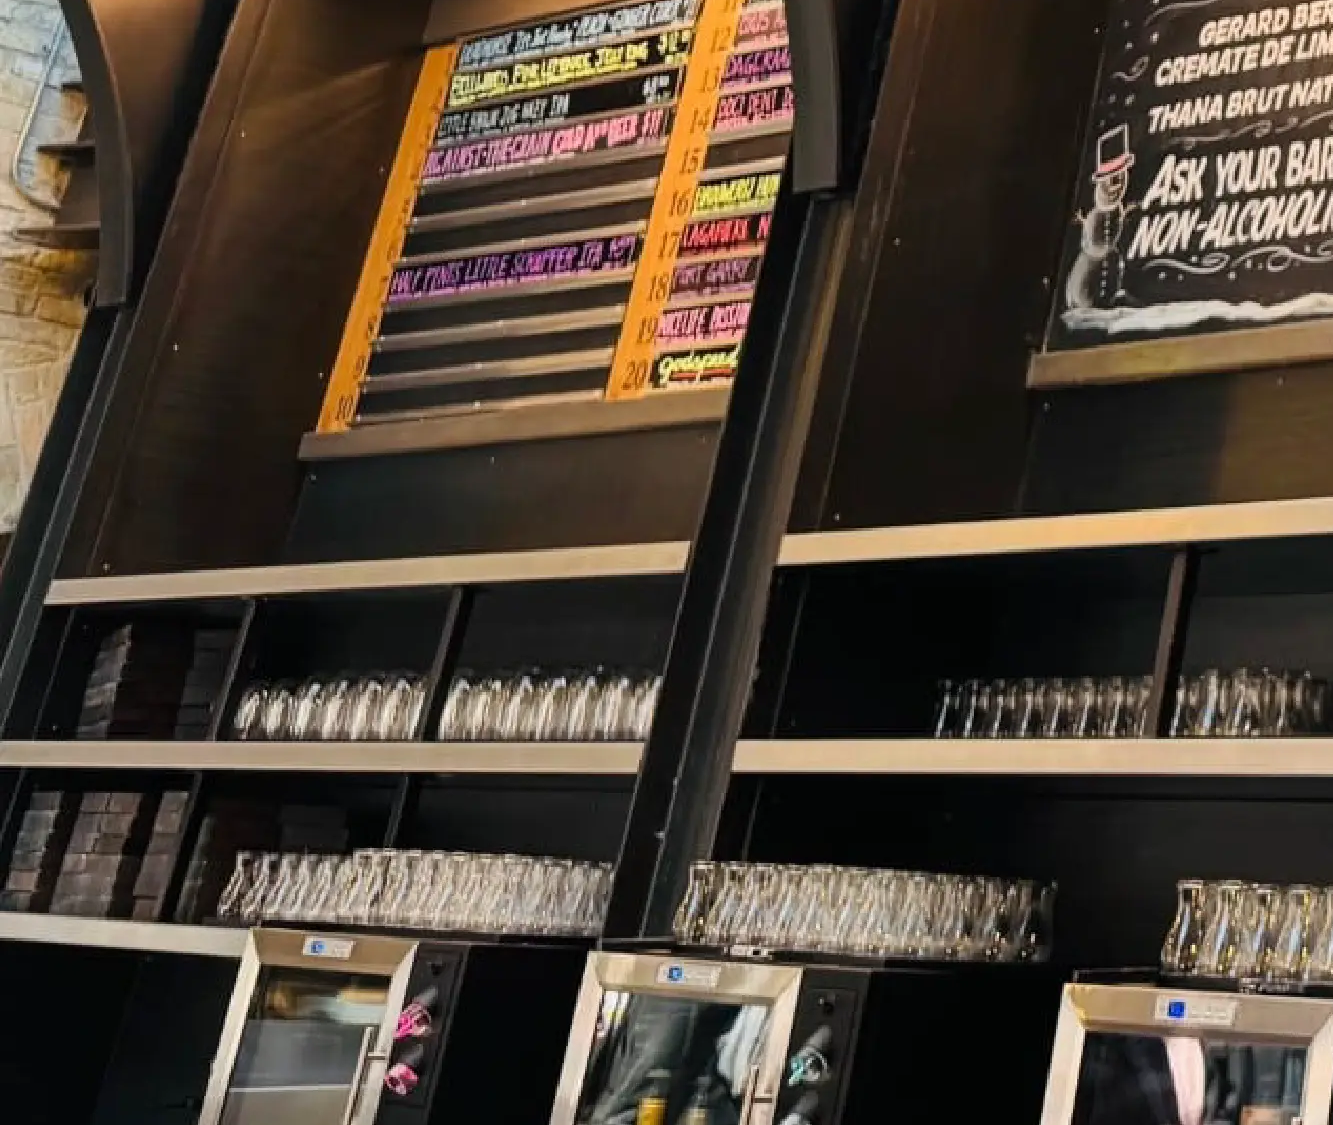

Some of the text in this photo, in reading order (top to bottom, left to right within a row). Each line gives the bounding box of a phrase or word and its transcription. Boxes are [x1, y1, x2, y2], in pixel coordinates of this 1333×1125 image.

[1200, 7, 1290, 47] GERARD
[1154, 46, 1259, 88] CREMATE
[1226, 85, 1288, 115] BRUT
[1142, 152, 1206, 210] ASK
[1214, 143, 1285, 200] YOUR
[669, 190, 688, 217] 16
[658, 231, 680, 258] 17
[622, 360, 648, 389] 20
